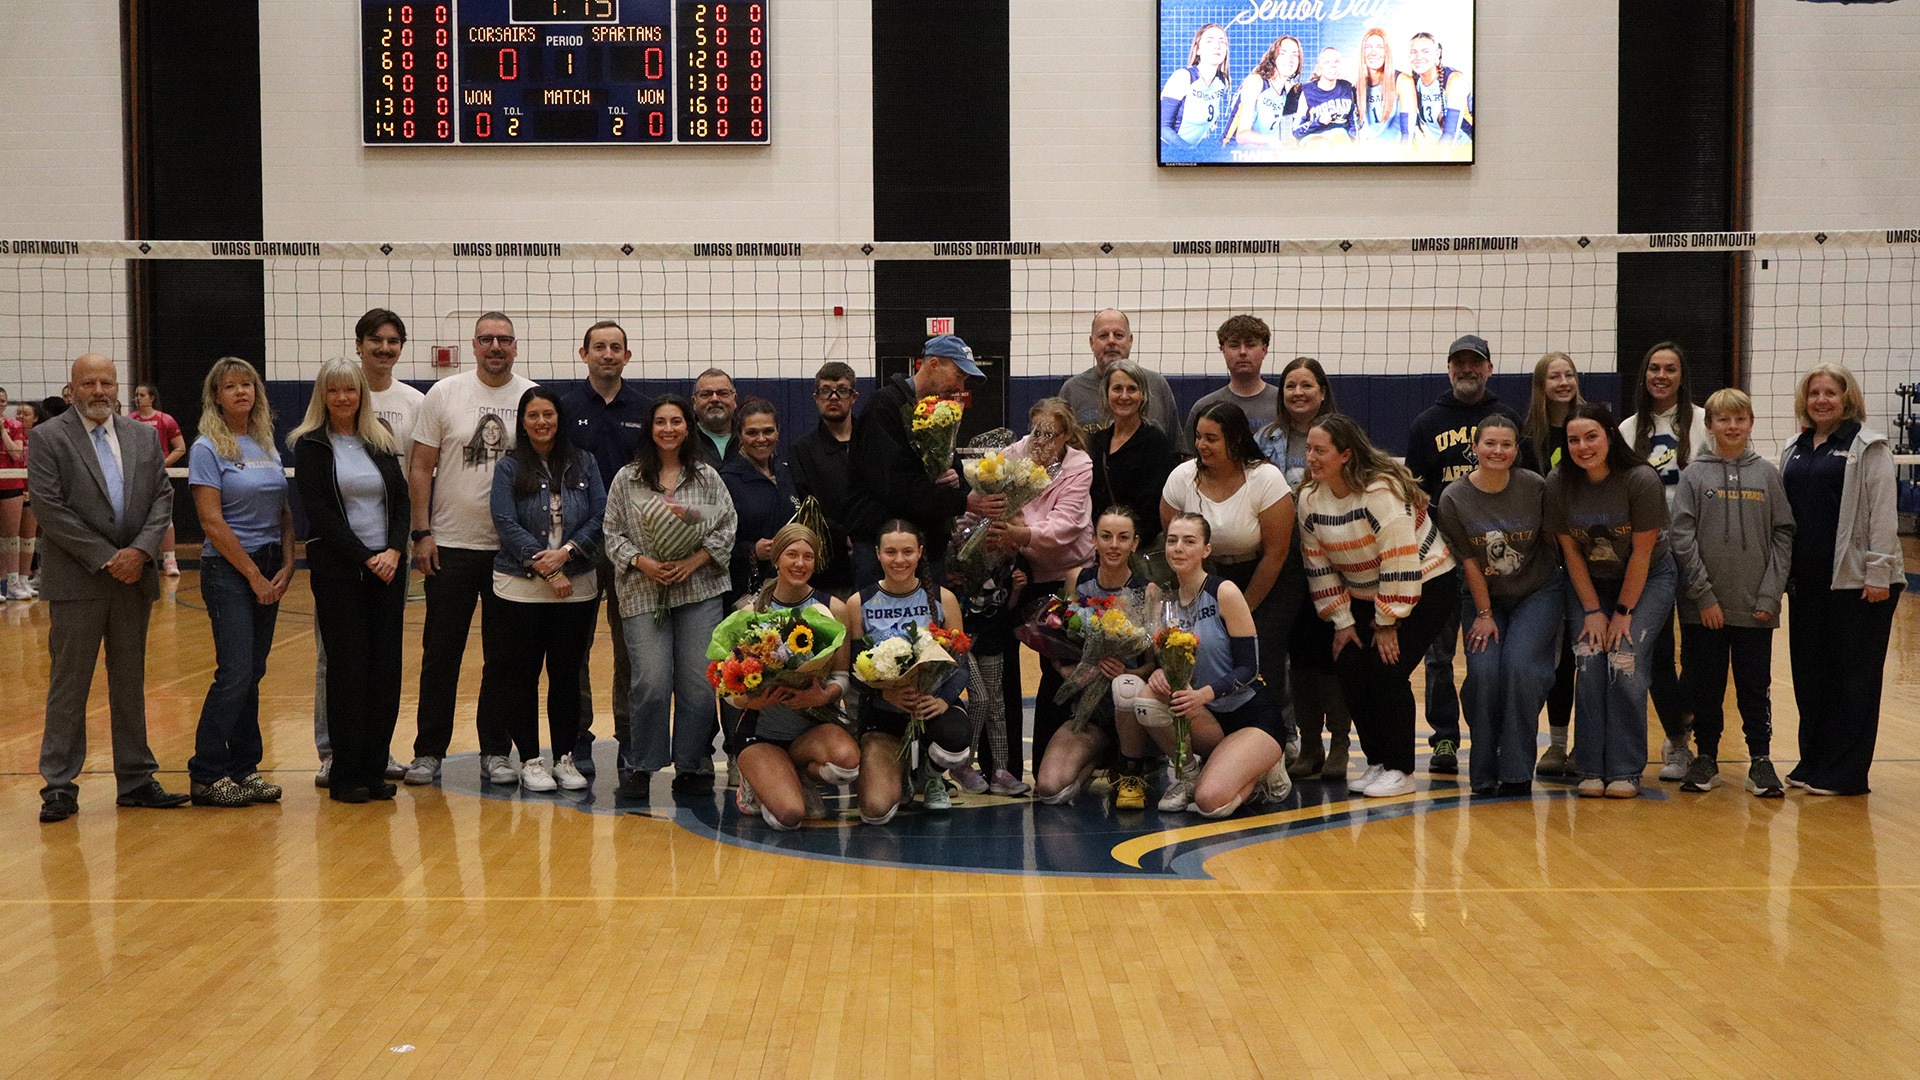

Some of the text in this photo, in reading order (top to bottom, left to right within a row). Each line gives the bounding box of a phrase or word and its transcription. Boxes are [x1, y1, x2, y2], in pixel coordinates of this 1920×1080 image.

[388, 5, 447, 24] 1 0 0
[695, 4, 761, 23] 2 0 0
[381, 28, 447, 47] 2 0 0
[469, 27, 536, 42] CORSAIRS
[546, 35, 583, 47] PERIOD
[591, 26, 662, 42] SPARTANS
[695, 27, 762, 46] 5 0 0
[381, 51, 448, 70] 6 0 0
[499, 48, 518, 80] 0
[567, 53, 573, 75] 1
[644, 47, 663, 80] 0
[689, 50, 762, 69] 12 0 0
[382, 74, 448, 93] 9 0 0
[689, 73, 762, 92] 13 0 0
[464, 90, 492, 105] WON
[544, 89, 591, 105] MATCH
[637, 89, 665, 104] WON
[690, 96, 763, 115] 16 0 0
[376, 98, 449, 116] 13 0 0
[503, 107, 524, 116] T.O.L.
[608, 106, 629, 116] T.O.L.
[1207, 104, 1215, 123] 9
[376, 120, 449, 139] 14 0 0
[476, 112, 491, 137] 0
[508, 118, 519, 137] 2
[612, 117, 624, 136] 2
[649, 111, 664, 137] 0
[690, 119, 763, 137] 18 0 0
[12, 240, 79, 255] DARTMOUTH
[211, 242, 320, 256] UMASS DARTMOUTH
[453, 242, 561, 257] UMASS DARTMOUTH
[693, 242, 801, 257] UMASS DARTMOUTH
[933, 241, 1041, 256] UMASS DARTMOUTH
[1172, 240, 1280, 255] UMASS DARTMOUTH
[1411, 236, 1519, 252] UMASS DARTMOUTH
[1649, 233, 1756, 248] UMASS DARTMOUTH
[931, 319, 950, 334] EXIT
[865, 605, 934, 620] CORSAIR
